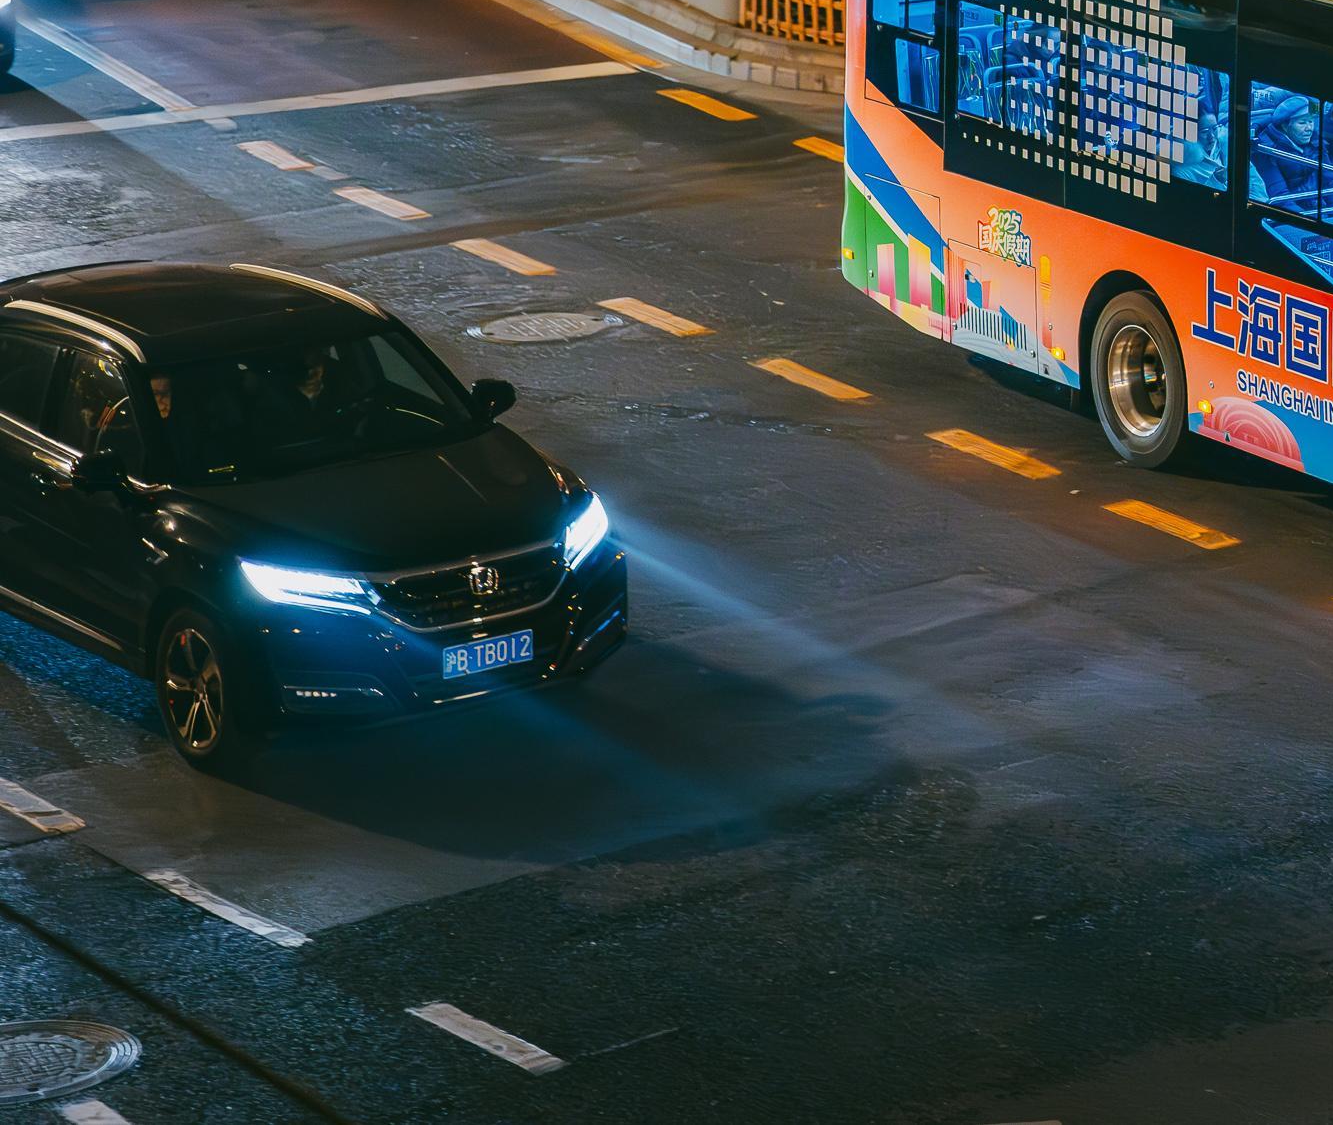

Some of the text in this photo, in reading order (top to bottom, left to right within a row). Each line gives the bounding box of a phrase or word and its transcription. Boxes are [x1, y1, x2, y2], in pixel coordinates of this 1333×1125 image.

[987, 207, 1020, 233] 2025
[979, 225, 1030, 265] 国庆假期
[1236, 370, 1321, 416] SHANGHAI
